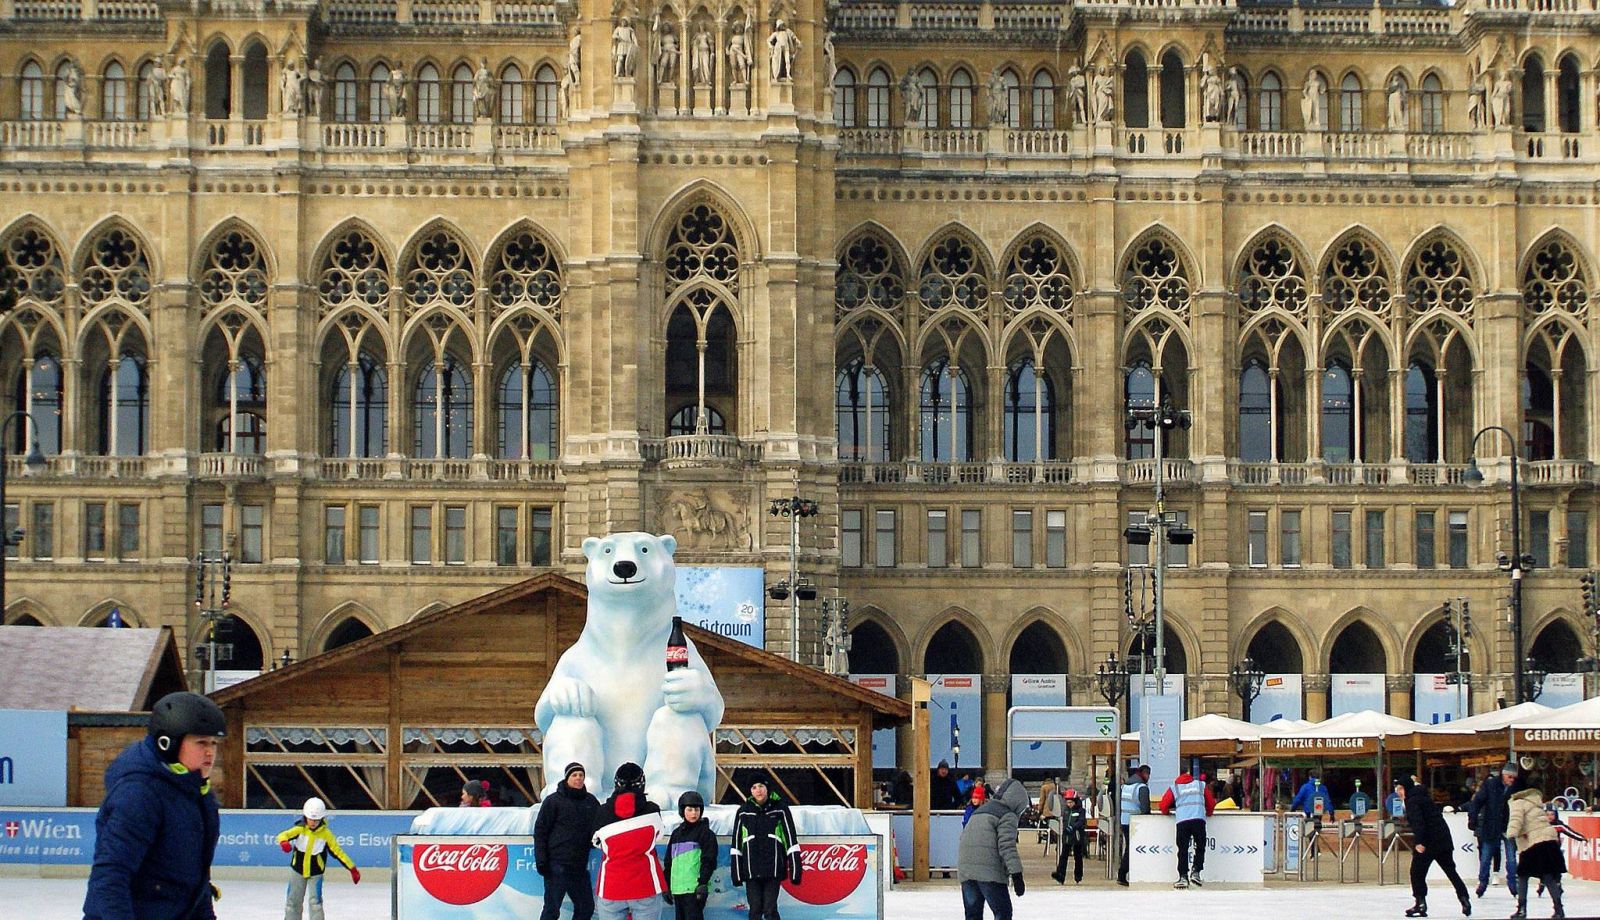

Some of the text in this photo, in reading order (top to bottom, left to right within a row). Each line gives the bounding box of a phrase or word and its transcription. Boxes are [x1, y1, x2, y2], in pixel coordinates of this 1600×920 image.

[740, 604, 754, 615] 20
[1326, 738, 1364, 748] BURGER
[21, 818, 82, 839] Wien
[217, 831, 259, 845] nscht
[359, 832, 392, 847] Eisv
[24, 845, 40, 855] ist
[418, 844, 506, 872] Coca-Cola
[799, 844, 864, 872] ca-Cola
